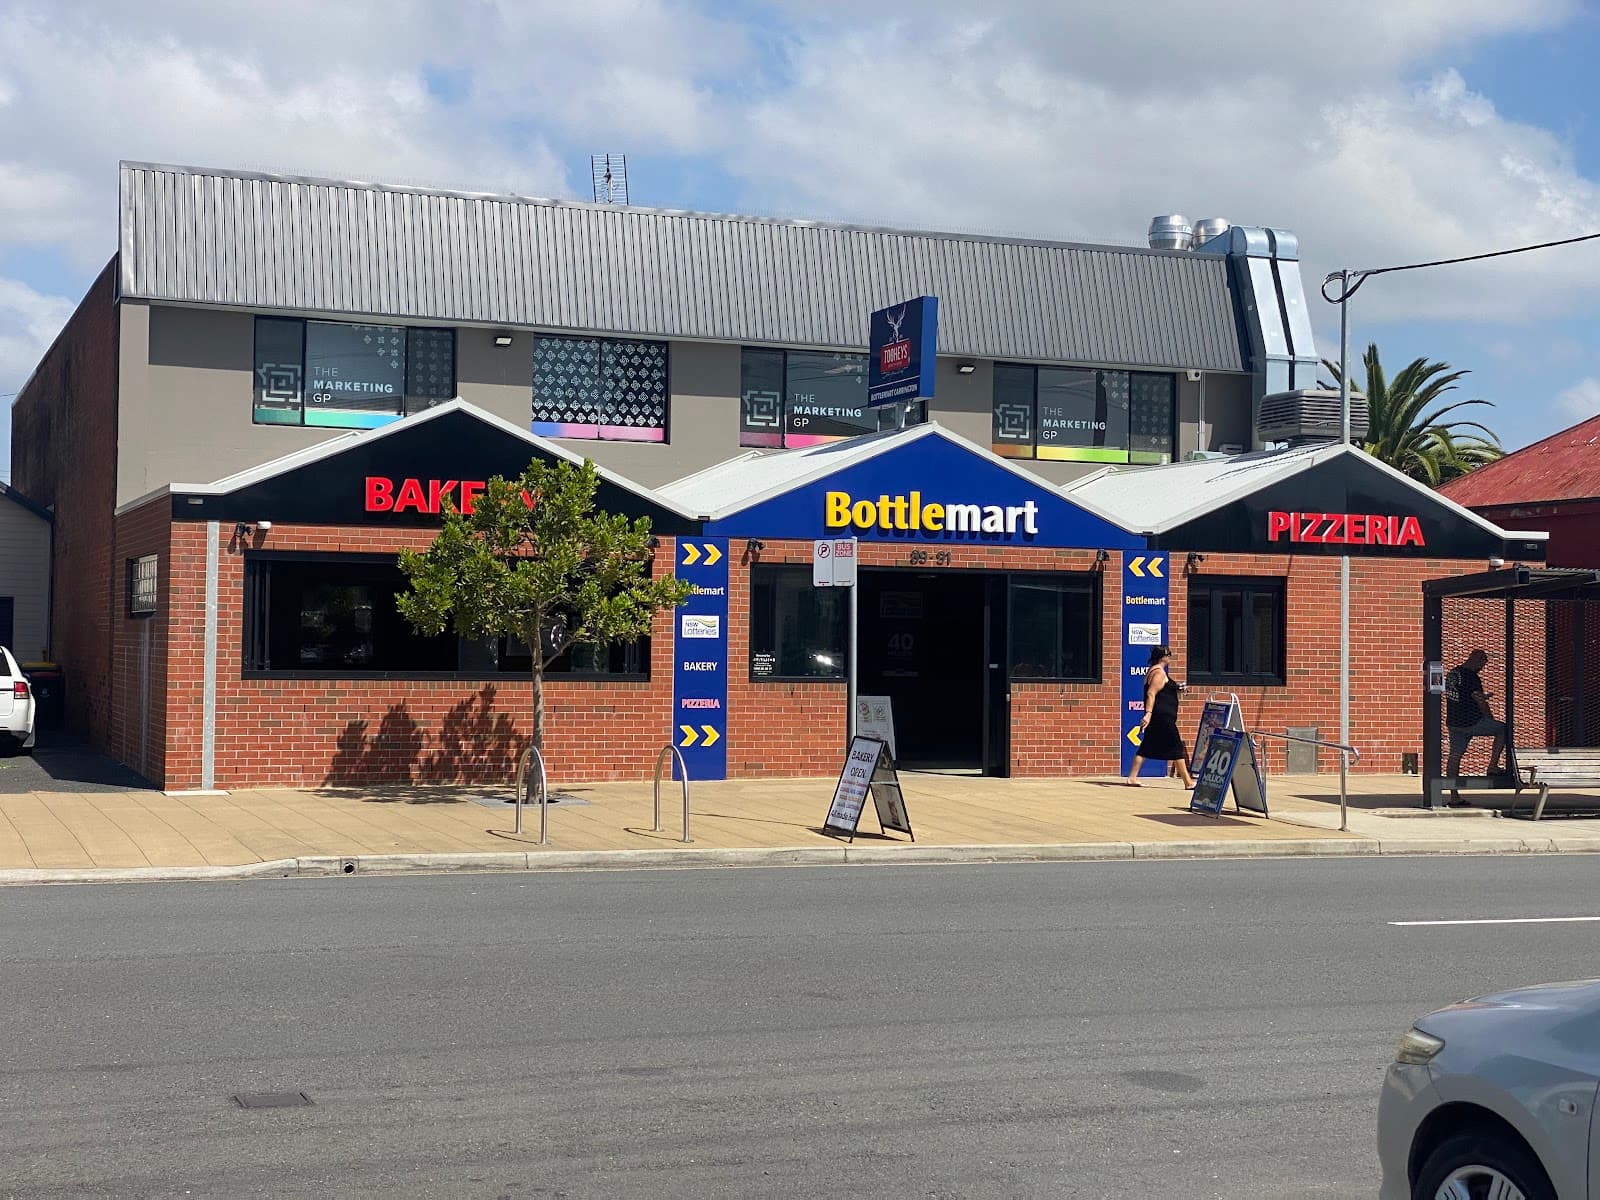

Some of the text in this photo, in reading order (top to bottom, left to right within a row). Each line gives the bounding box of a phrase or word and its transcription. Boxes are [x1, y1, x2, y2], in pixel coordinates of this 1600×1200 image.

[885, 344, 908, 363] TOOHEYS
[313, 366, 339, 377] THE
[313, 380, 394, 393] MARKETING
[312, 393, 332, 403] GP
[793, 393, 816, 403] THE
[793, 405, 862, 418] MARKETING
[1043, 406, 1063, 417] THE
[793, 418, 809, 428] GP
[1042, 418, 1107, 431] MARKETING
[1042, 430, 1058, 440] GP
[365, 476, 541, 515] BAKE
[825, 490, 1039, 535] Bottlemart
[1268, 511, 1425, 547] PIZZERIA
[690, 585, 725, 596] tlemart
[1125, 595, 1166, 605] Bottlemart
[683, 661, 718, 671] BAKERY
[1130, 667, 1149, 676] BAK
[681, 698, 721, 709] PIZZERIA
[1128, 701, 1145, 711] PIZZ
[852, 750, 875, 763] BAKERY
[850, 767, 867, 778] OPEN
